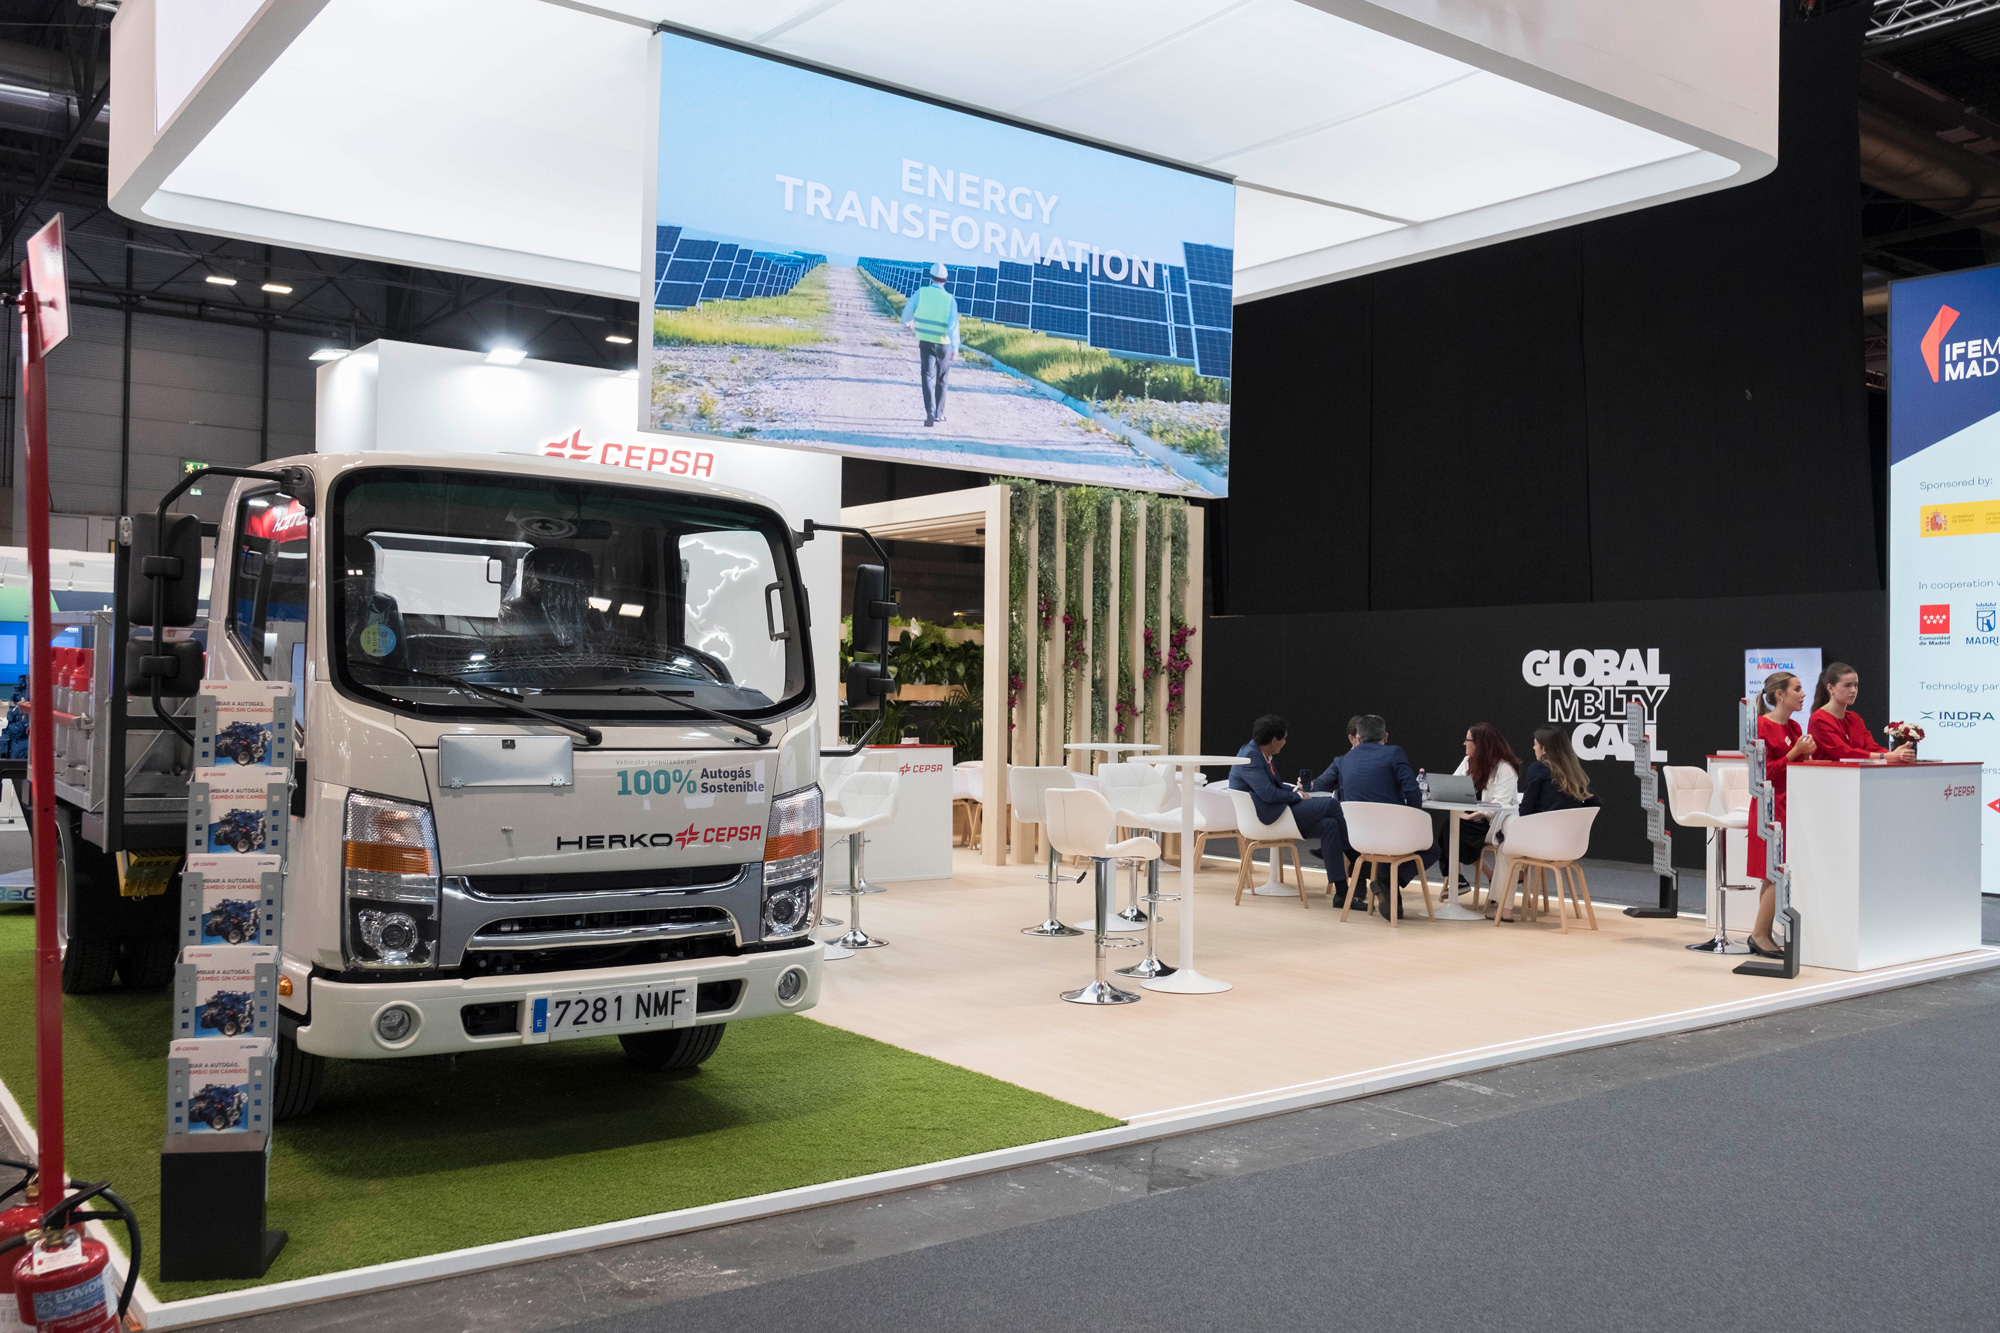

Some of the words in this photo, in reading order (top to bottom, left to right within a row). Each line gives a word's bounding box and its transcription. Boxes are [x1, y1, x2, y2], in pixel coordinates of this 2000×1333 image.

[902, 158, 1059, 225] ENERGY
[775, 173, 1155, 288] TRANSFORMATION
[1945, 357, 1999, 382] MAD
[600, 443, 714, 477] CEPSA
[1920, 477, 1975, 492] Sponsored
[1978, 477, 1993, 487] by:
[1918, 582, 1928, 590] In
[1930, 579, 1993, 591] cooperation
[1522, 648, 1670, 687] GLOBAL
[1919, 681, 1979, 693] Technology
[1939, 711, 1995, 721] INDRA
[647, 759, 685, 767] propulsado
[686, 758, 698, 766] por
[912, 764, 943, 773] CEPSA
[700, 767, 751, 781] Autogás
[617, 769, 697, 796] 100%
[701, 781, 765, 794] Sostenible
[1953, 785, 1975, 797] CEPSA
[557, 833, 674, 850] HERKO
[703, 825, 762, 843] CEPSA
[554, 995, 622, 1028] 7281
[635, 989, 686, 1019] NMF
[536, 1019, 543, 1027] E
